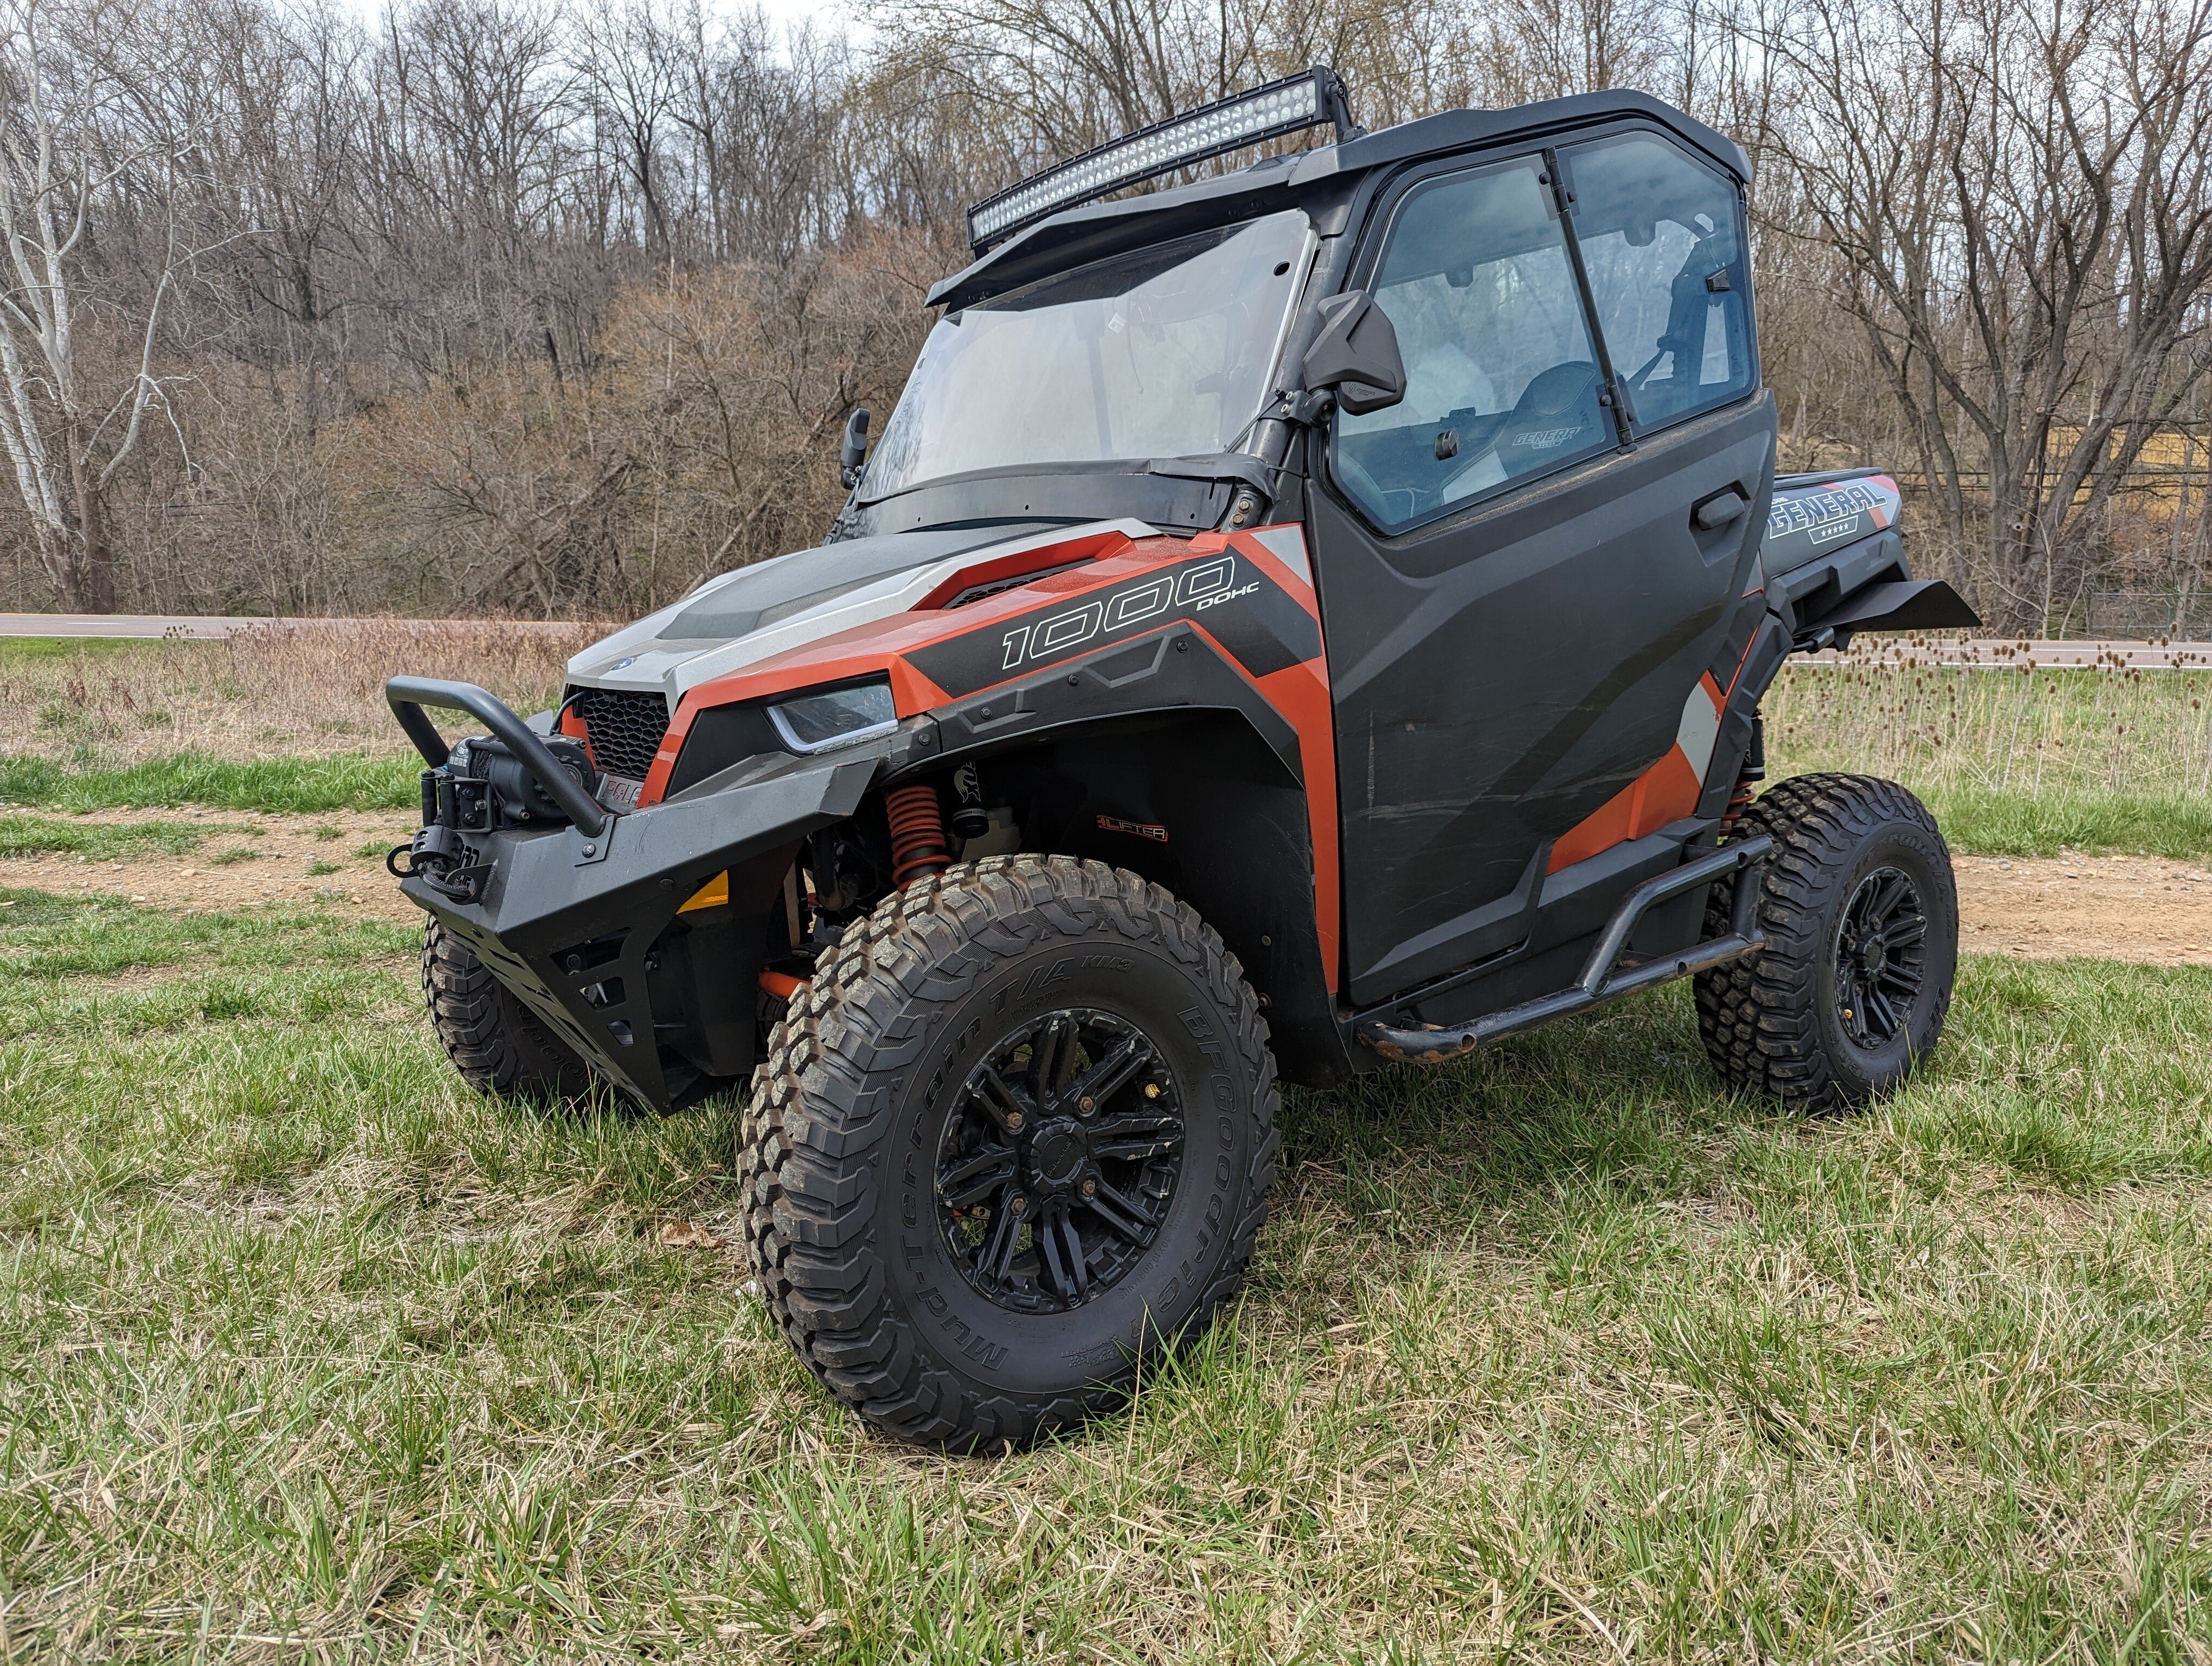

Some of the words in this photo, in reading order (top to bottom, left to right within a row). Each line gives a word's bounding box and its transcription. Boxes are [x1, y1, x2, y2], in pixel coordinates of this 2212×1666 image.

[1512, 426, 1583, 446] GENERA
[1767, 484, 1887, 540] GENERAL
[1002, 556, 1235, 670] 1000
[1195, 581, 1259, 611] DOHC
[899, 1016, 1009, 1371] Mud-Terrain
[988, 957, 1076, 1016] T/A
